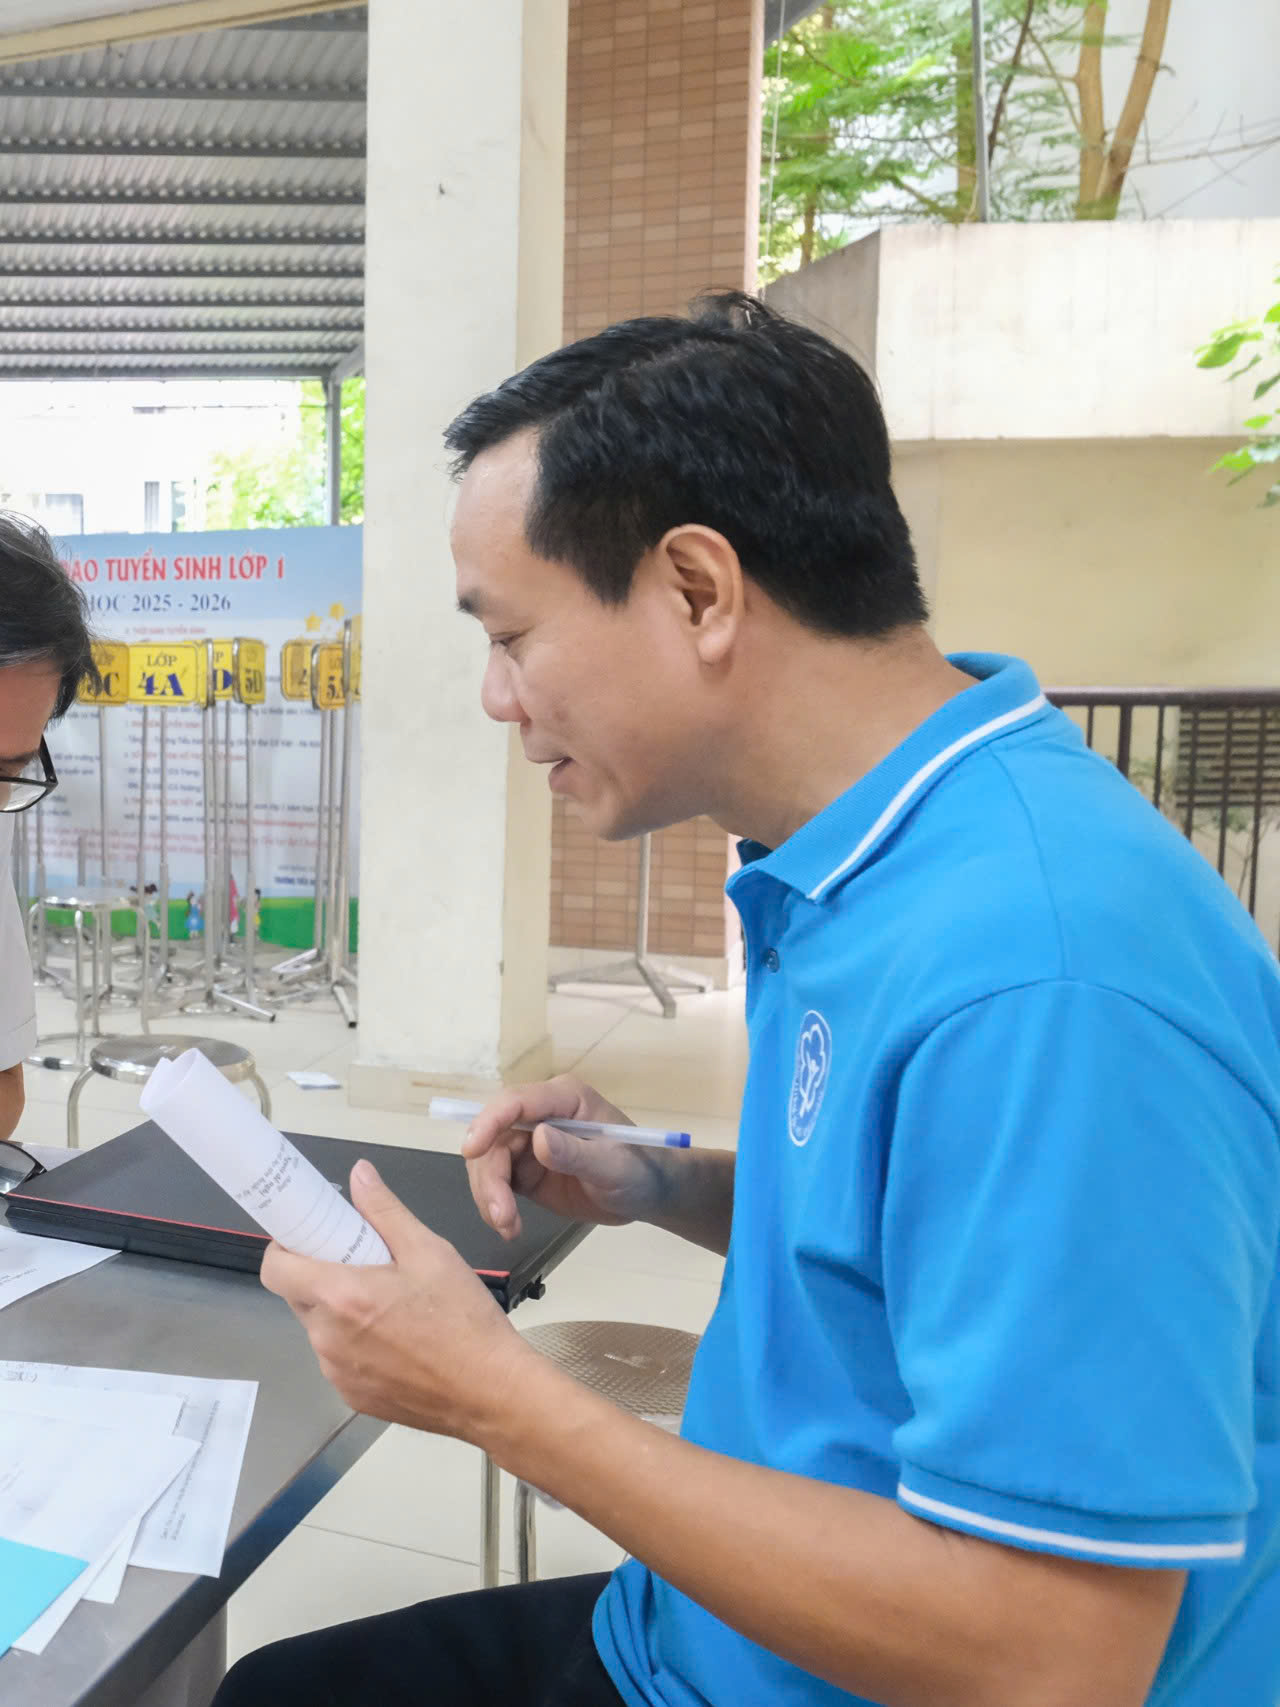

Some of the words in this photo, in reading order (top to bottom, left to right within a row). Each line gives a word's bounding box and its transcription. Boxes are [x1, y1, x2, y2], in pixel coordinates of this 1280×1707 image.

[174, 555, 221, 580] SINH
[228, 550, 268, 580] LỚP
[277, 558, 285, 579] 1
[132, 593, 172, 612] 2025
[190, 592, 232, 612] 2026
[146, 651, 178, 667] LỚP
[138, 671, 184, 697] 4A
